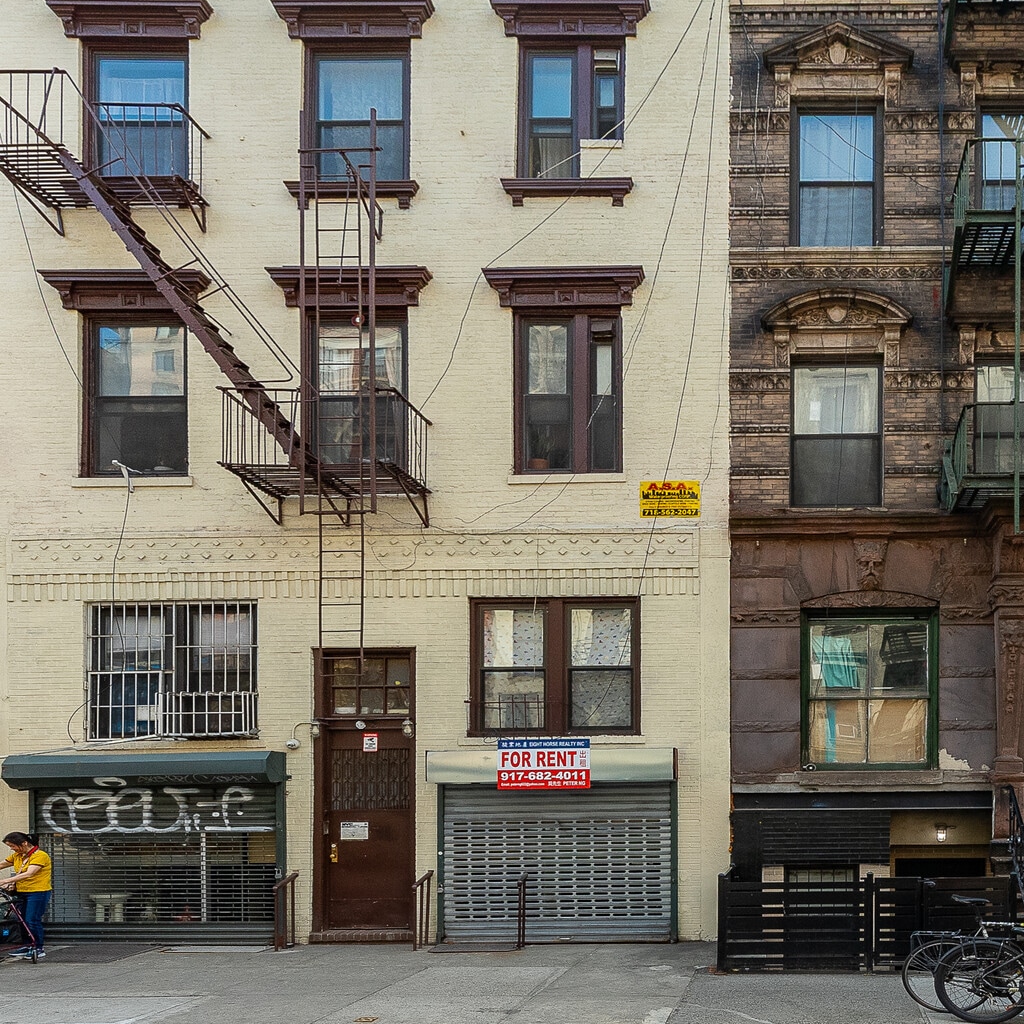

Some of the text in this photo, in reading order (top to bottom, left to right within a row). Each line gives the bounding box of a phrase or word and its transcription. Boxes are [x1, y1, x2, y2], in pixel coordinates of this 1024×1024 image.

[501, 751, 577, 767] FOR RENT
[501, 772, 586, 781] 917-682-4011
